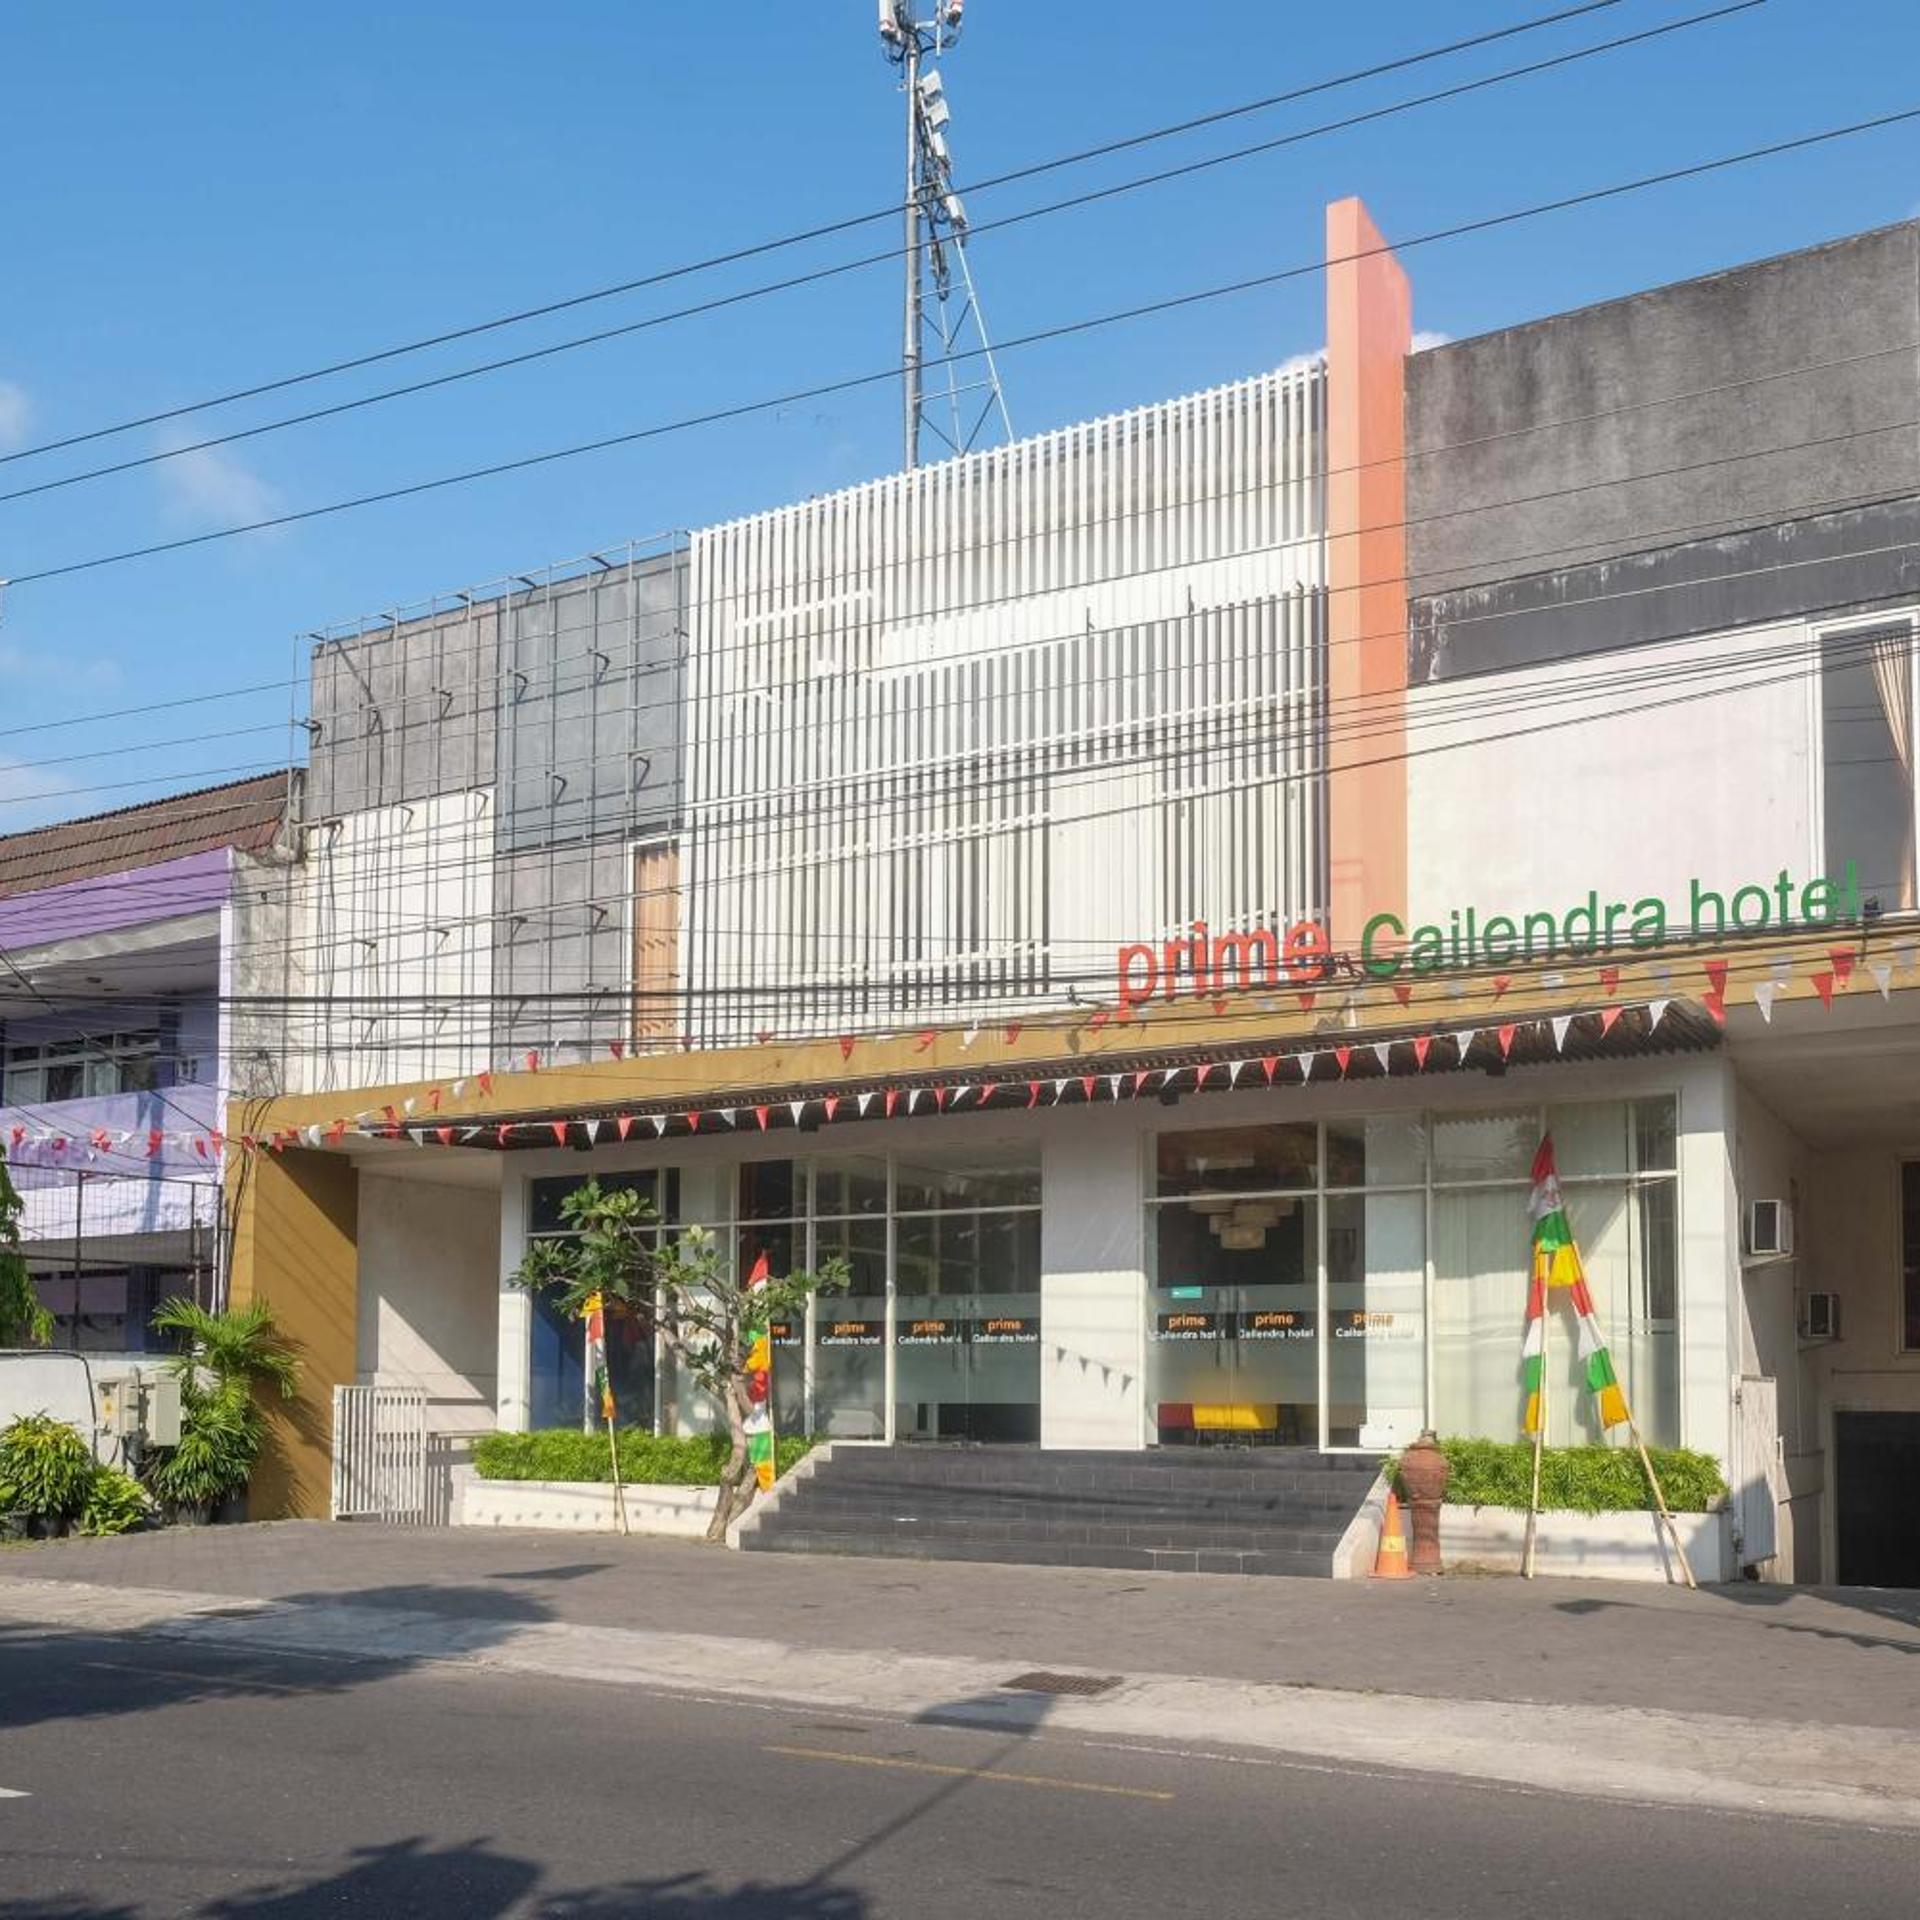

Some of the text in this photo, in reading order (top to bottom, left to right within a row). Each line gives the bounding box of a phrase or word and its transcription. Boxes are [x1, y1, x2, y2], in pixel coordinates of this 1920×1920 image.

[1118, 859, 1858, 1020] prime Cailendra hotel
[912, 1319, 946, 1335] prime
[987, 1317, 1022, 1334] prime
[1168, 1313, 1207, 1330] prime
[1254, 1312, 1294, 1328] prime
